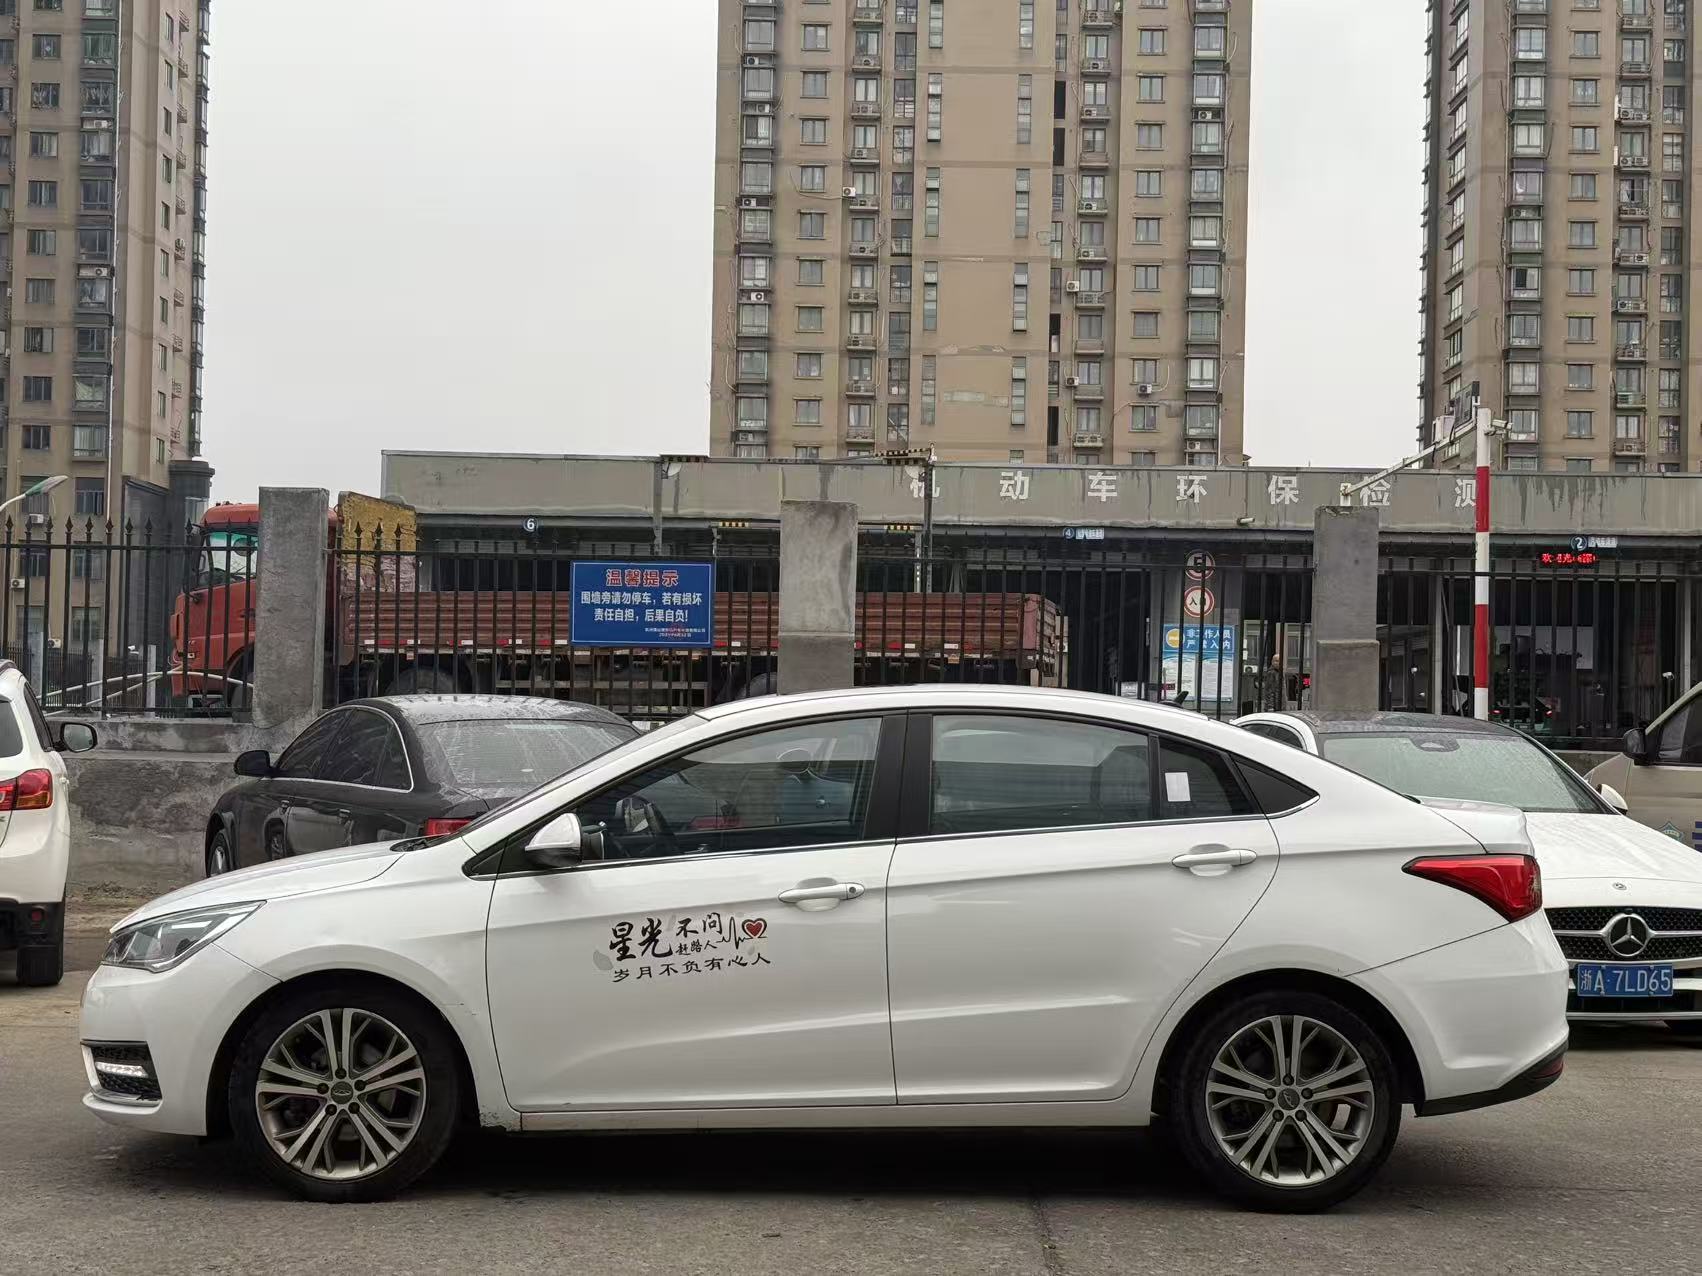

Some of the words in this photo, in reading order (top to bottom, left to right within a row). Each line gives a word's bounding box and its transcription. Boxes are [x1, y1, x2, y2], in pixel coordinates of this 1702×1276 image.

[606, 568, 679, 588] 温馨提示
[581, 591, 702, 607] 围墙旁请勿停车，若有损坏
[612, 952, 771, 983] 岁月不负有心人
